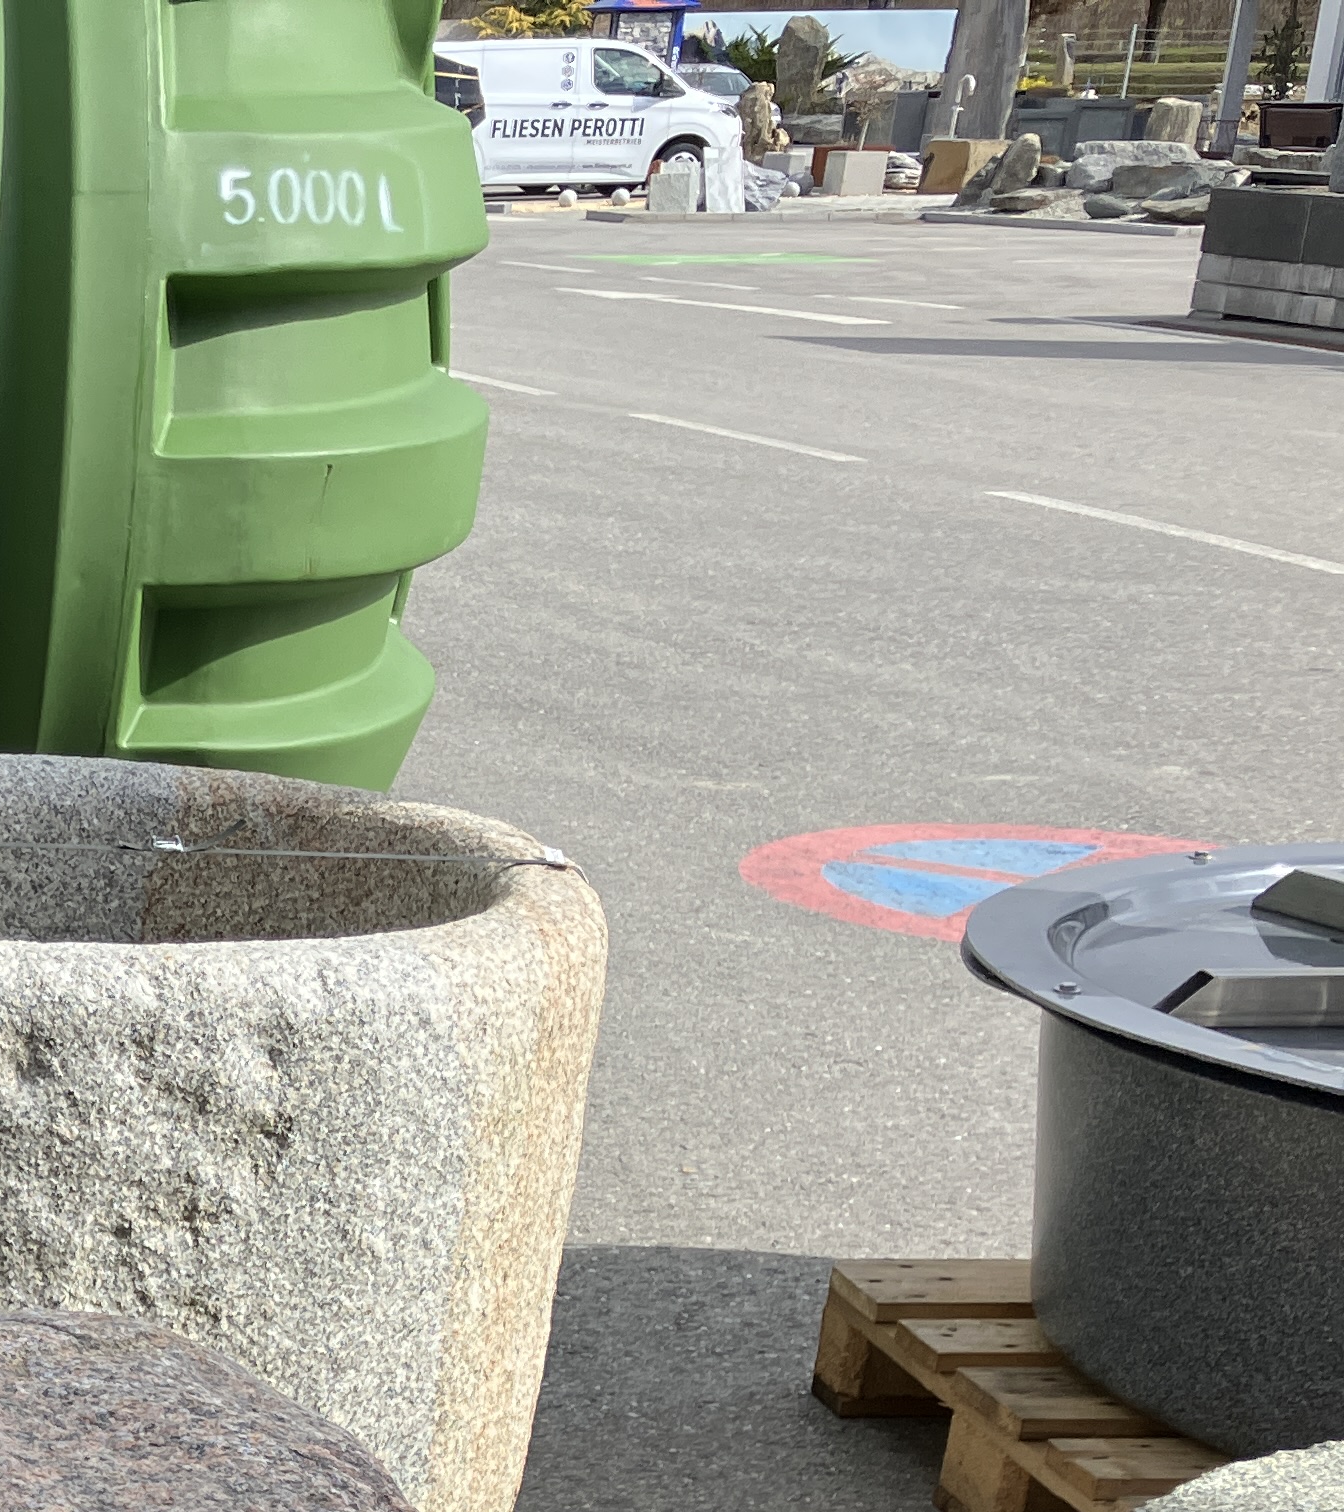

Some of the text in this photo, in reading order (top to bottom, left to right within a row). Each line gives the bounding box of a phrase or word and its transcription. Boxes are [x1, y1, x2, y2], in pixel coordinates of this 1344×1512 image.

[491, 117, 645, 139] FLIESEN PEROTTI
[219, 166, 366, 226] 5.000
